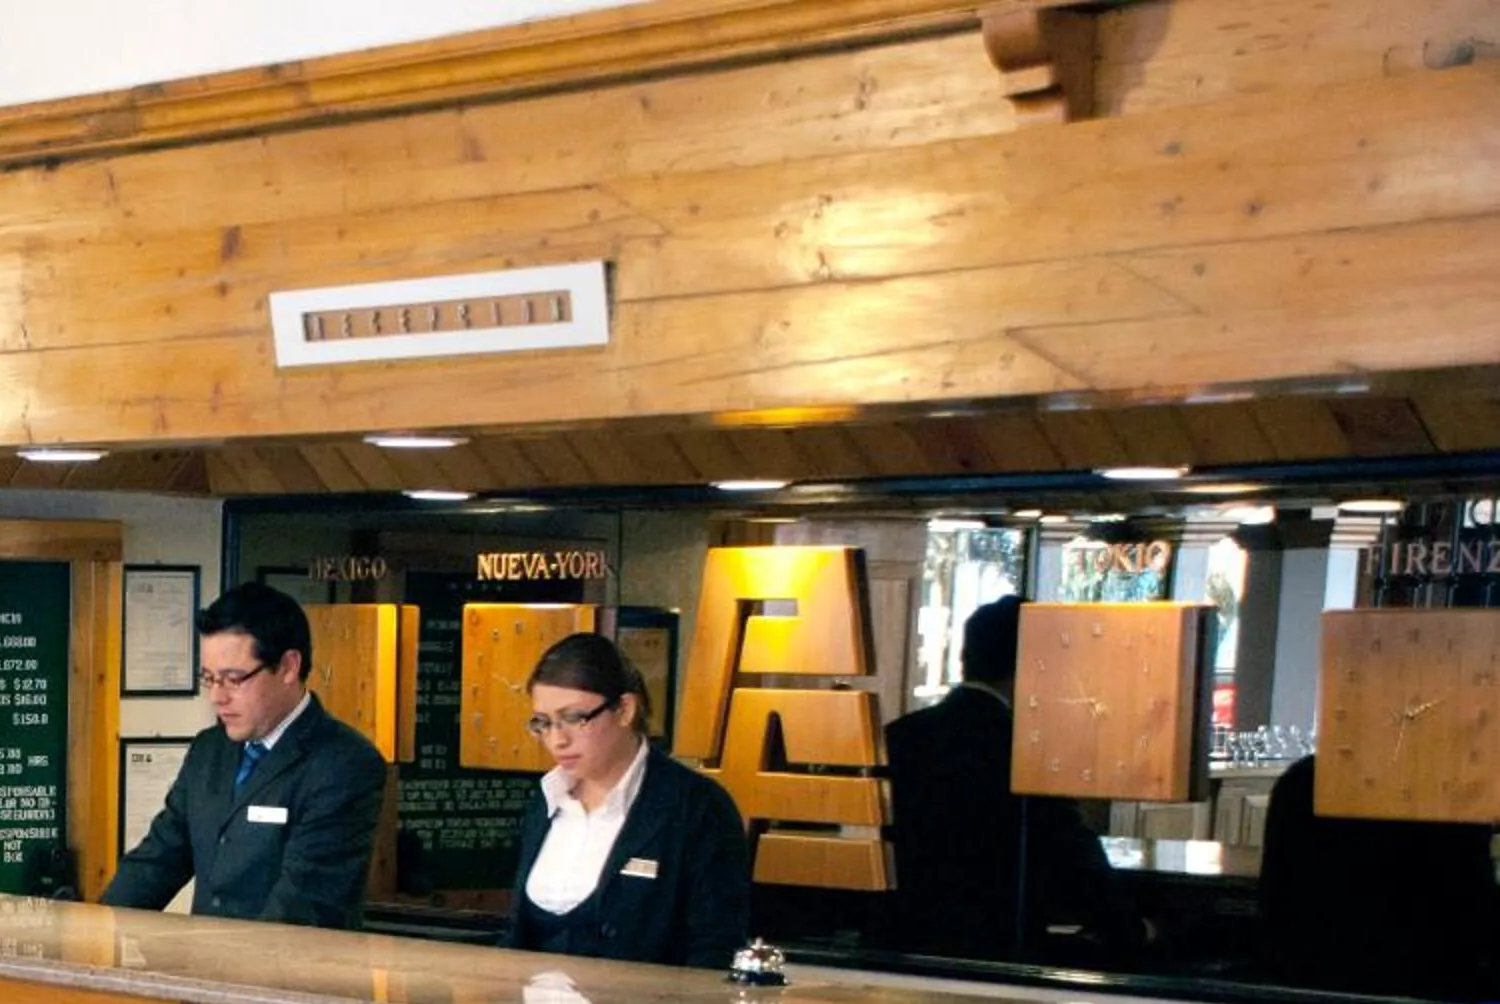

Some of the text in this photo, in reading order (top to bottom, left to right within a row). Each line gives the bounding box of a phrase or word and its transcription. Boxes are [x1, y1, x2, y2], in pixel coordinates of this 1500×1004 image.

[1068, 540, 1172, 574] TOKIO
[19, 798, 35, 808] NO
[4, 840, 22, 851] NOT
